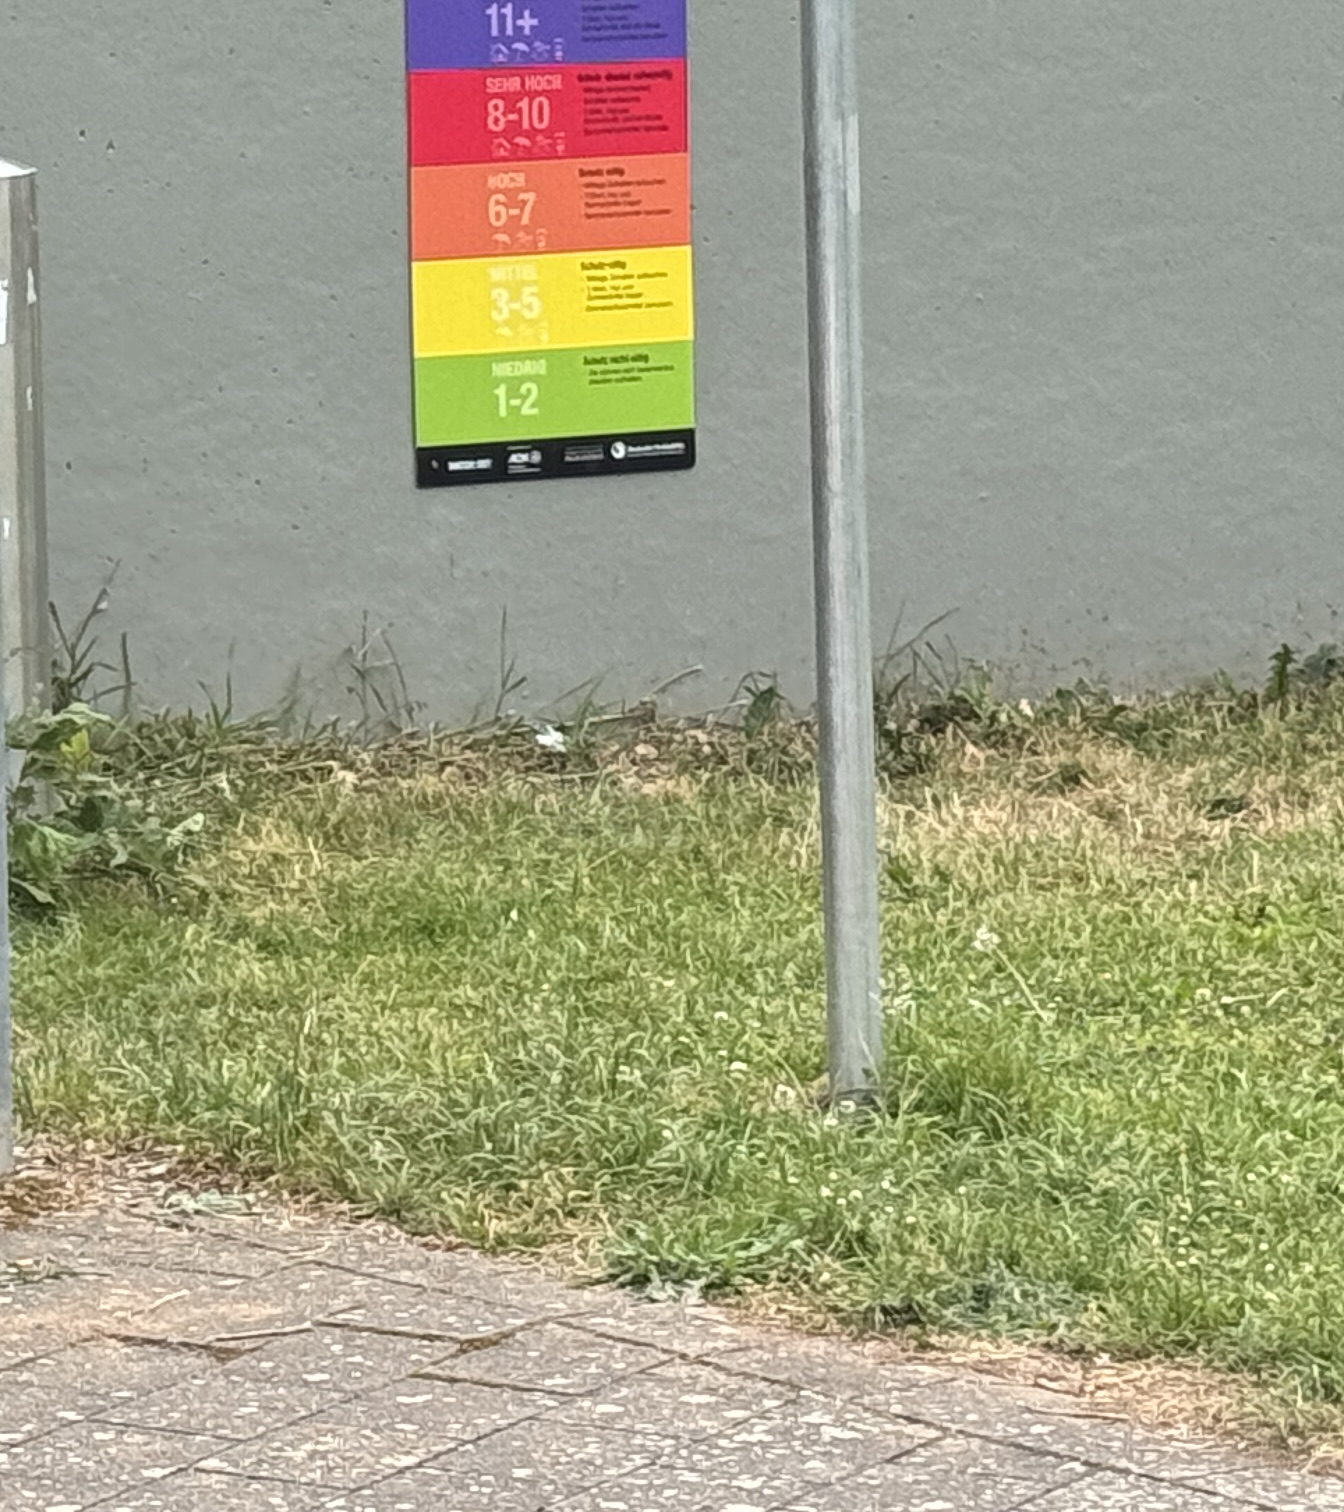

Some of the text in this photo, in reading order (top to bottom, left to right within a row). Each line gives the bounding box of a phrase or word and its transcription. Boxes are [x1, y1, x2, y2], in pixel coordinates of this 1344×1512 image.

[485, 2, 539, 37] 11+
[486, 74, 521, 93] SEHR
[487, 96, 550, 132] 8-10
[488, 191, 537, 227] 6-7
[490, 285, 542, 322] 3-5
[493, 382, 539, 418] 1-2
